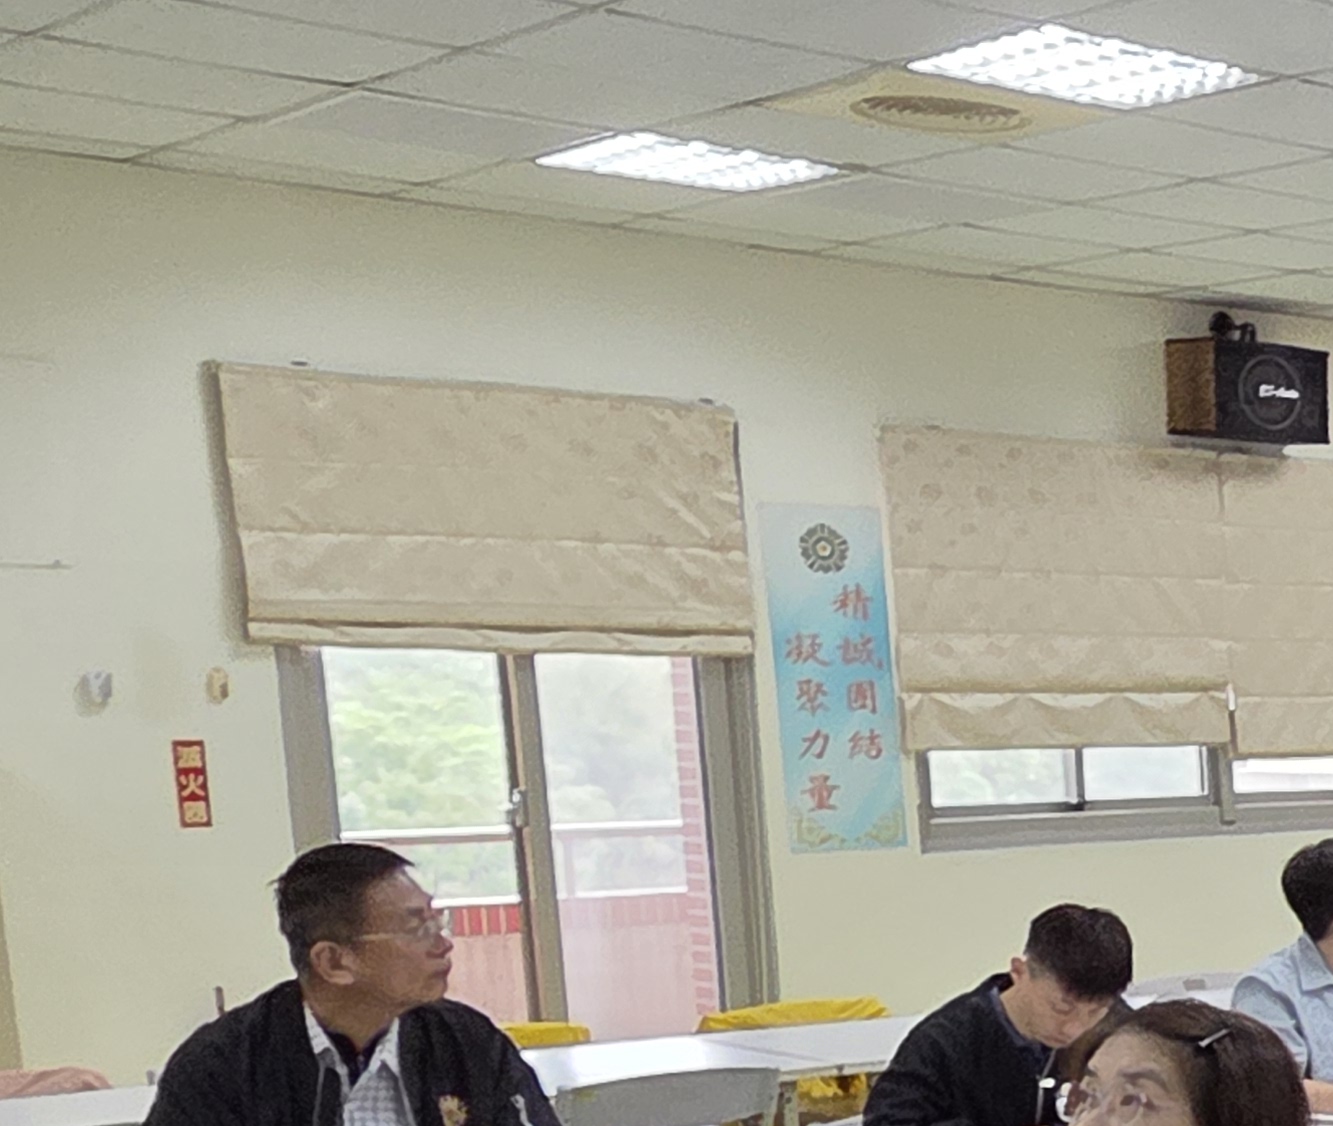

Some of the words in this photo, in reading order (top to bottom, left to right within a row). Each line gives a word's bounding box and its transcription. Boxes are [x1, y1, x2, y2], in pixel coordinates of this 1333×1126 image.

[785, 632, 841, 812] 凝聚力量
[833, 583, 884, 761] 精誠團結
